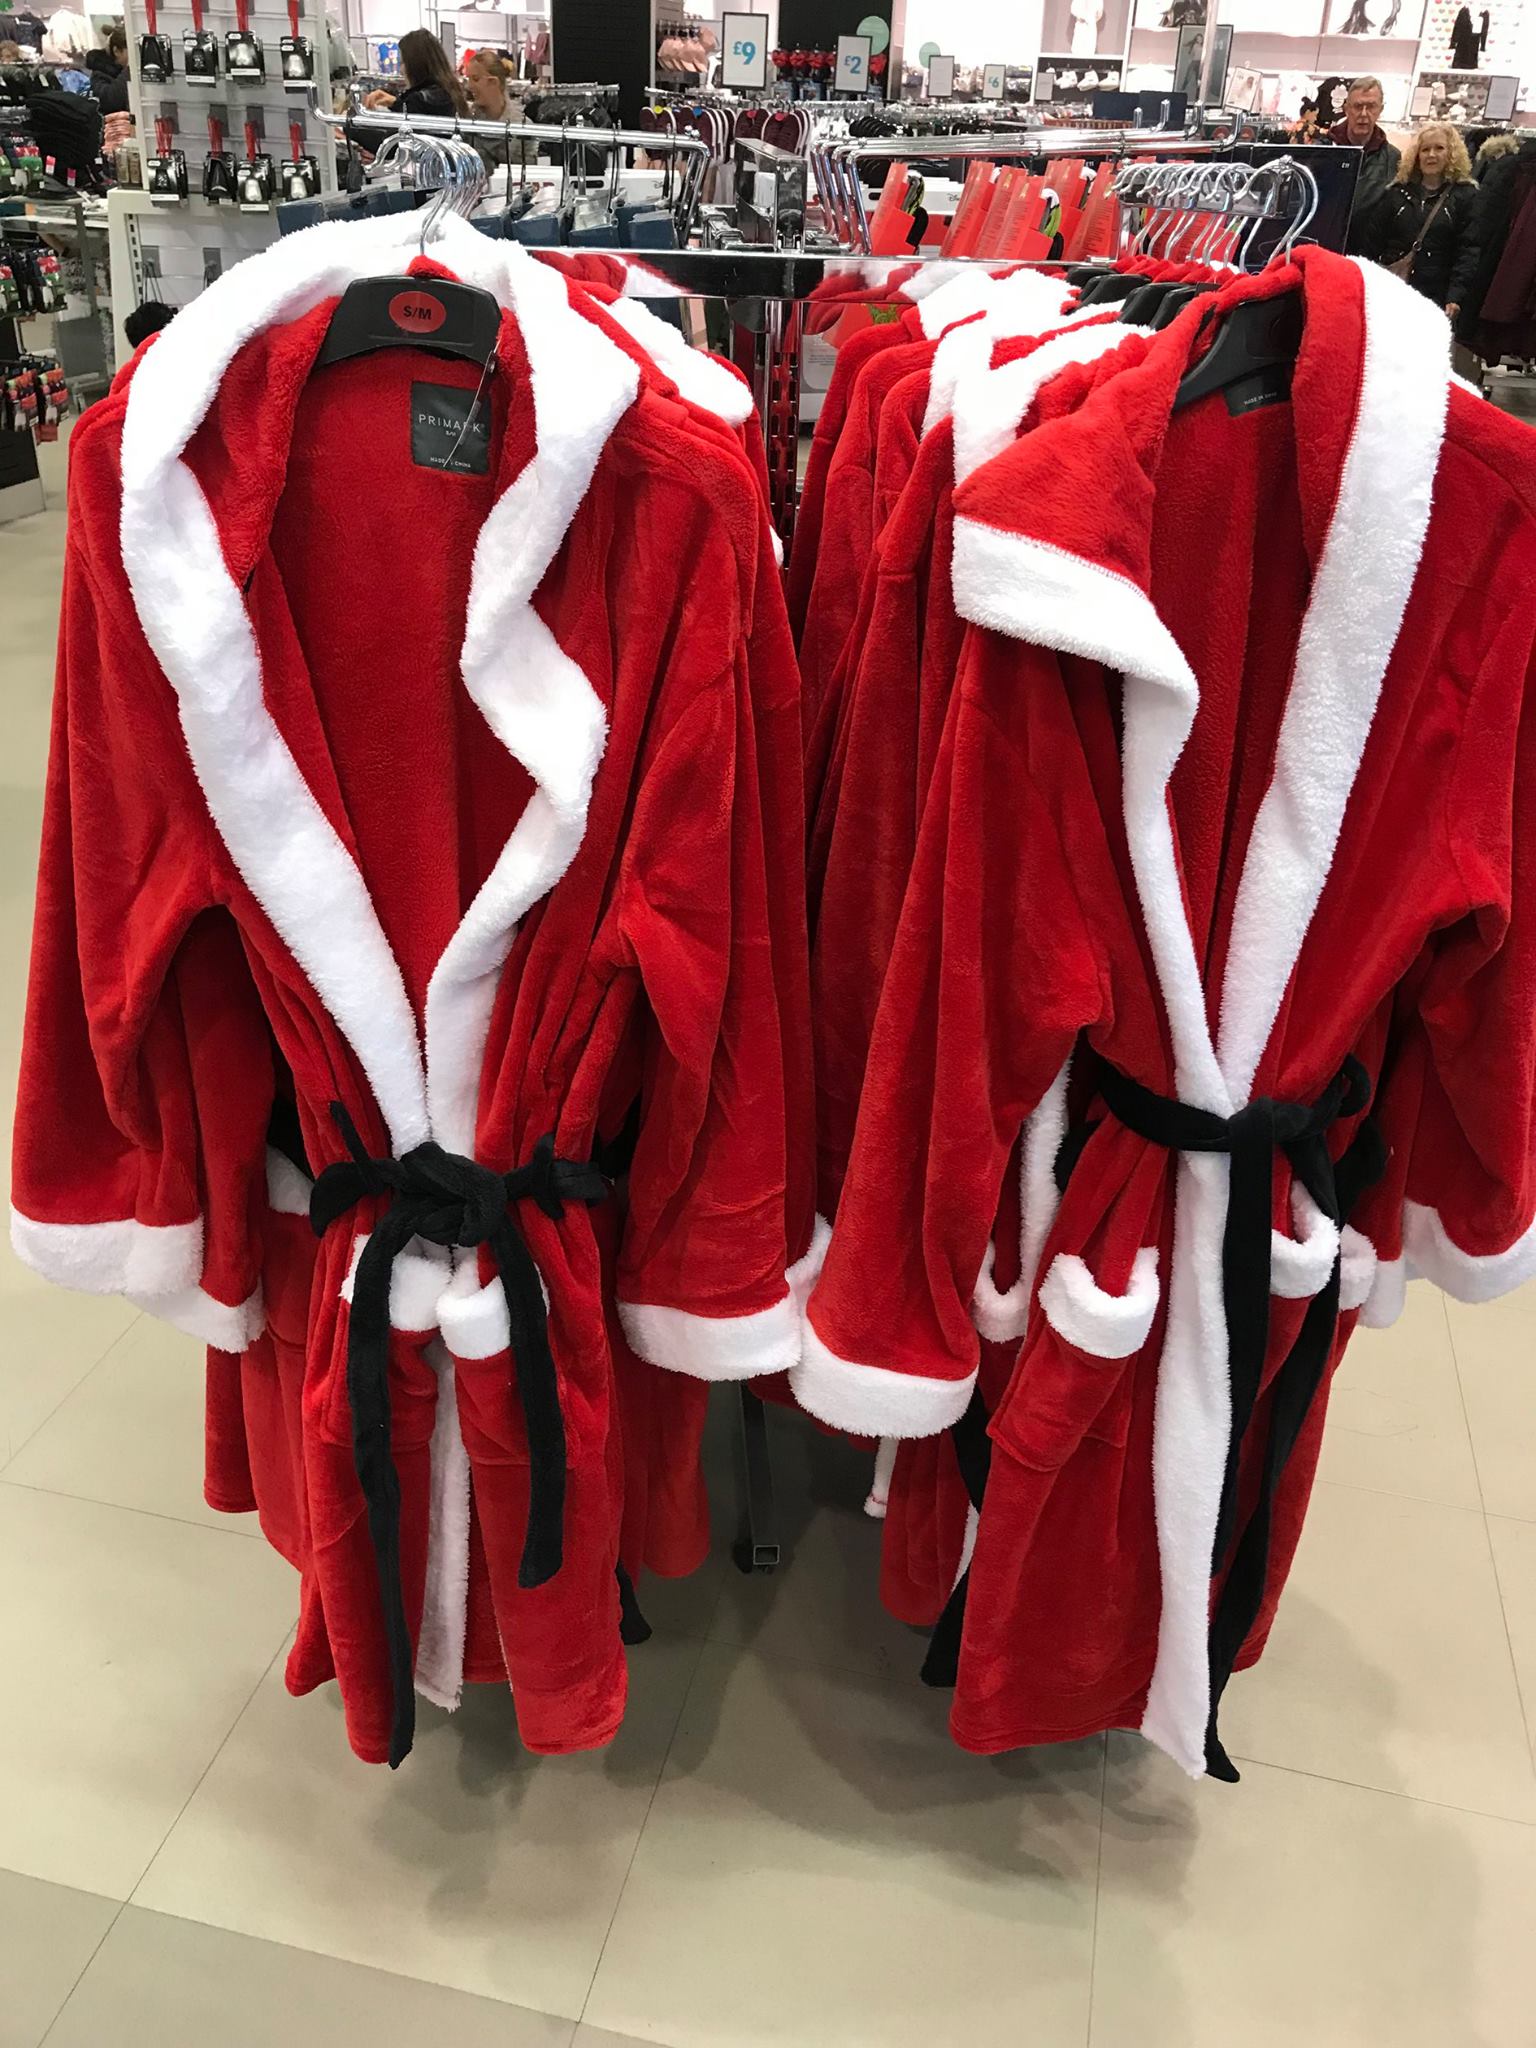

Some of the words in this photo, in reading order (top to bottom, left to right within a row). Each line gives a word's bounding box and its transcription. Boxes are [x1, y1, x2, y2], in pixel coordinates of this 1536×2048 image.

[733, 41, 757, 65] £9
[844, 55, 862, 74] £2
[403, 305, 432, 320] S/M
